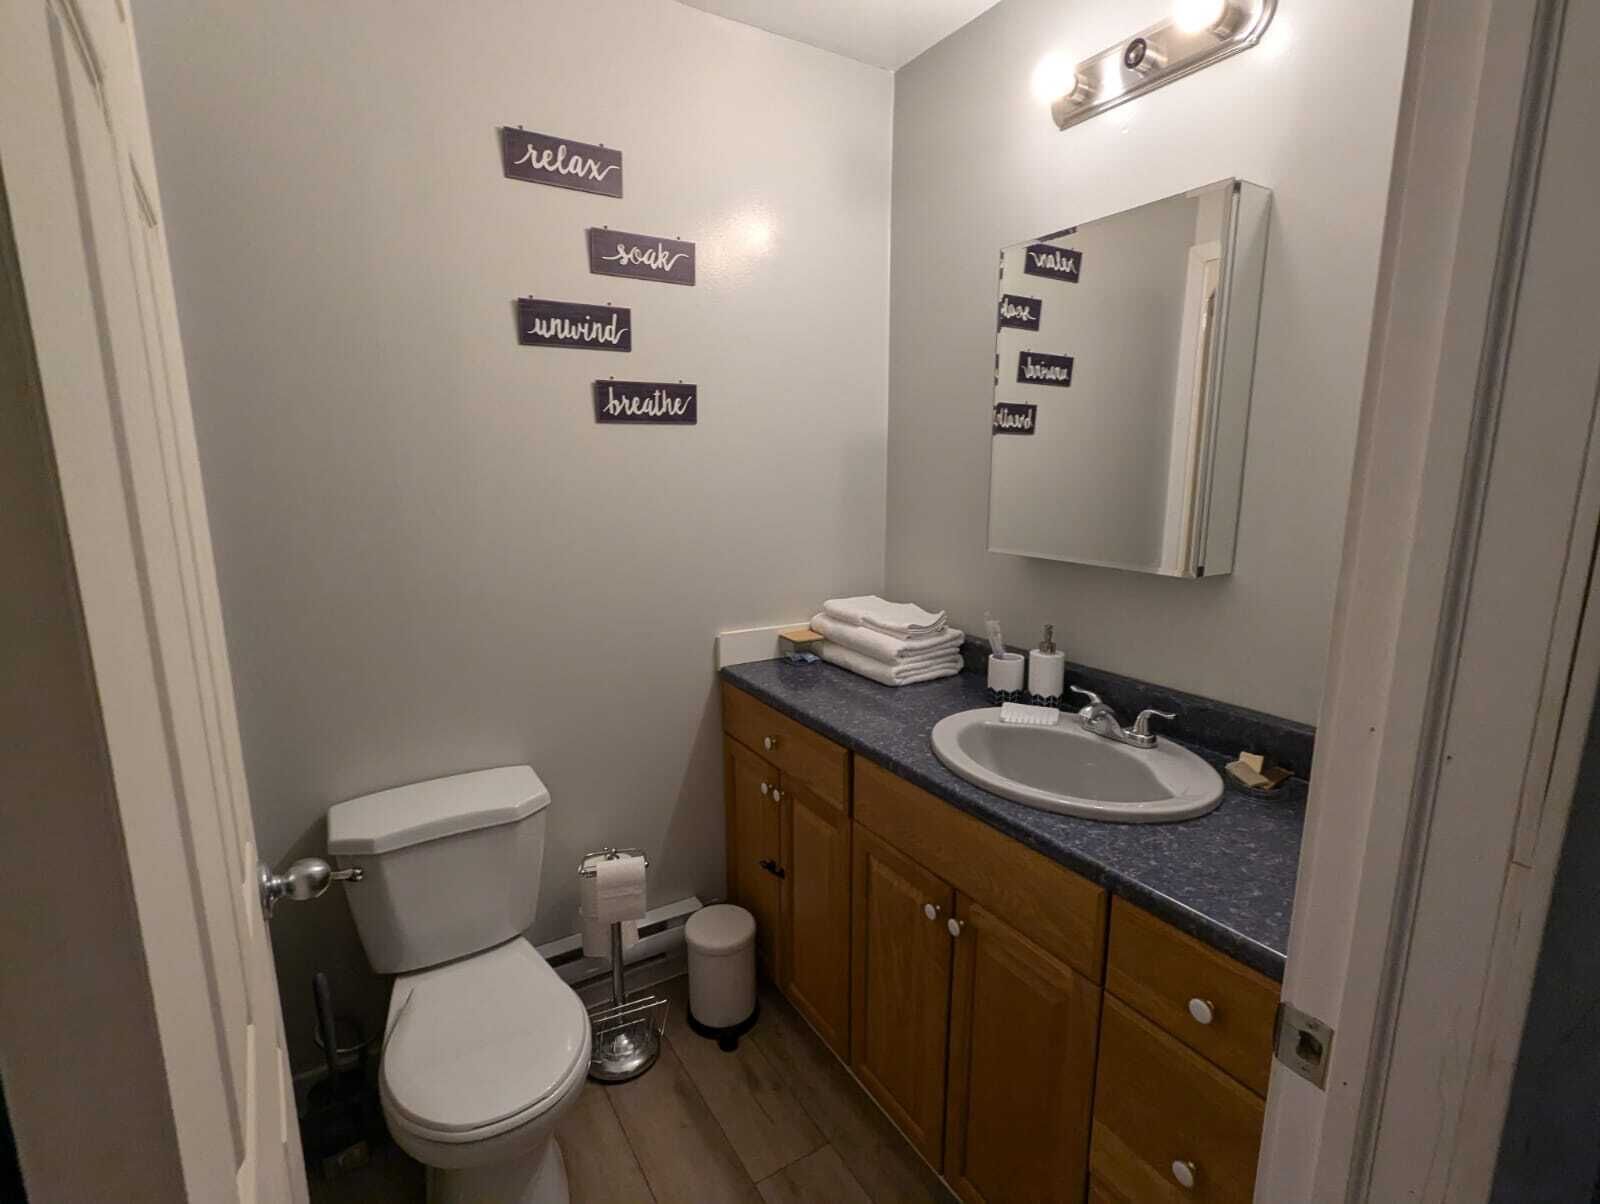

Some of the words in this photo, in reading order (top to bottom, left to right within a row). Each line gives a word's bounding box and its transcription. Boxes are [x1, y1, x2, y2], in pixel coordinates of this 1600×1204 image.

[514, 144, 620, 180] relax
[602, 243, 689, 271] soak
[528, 313, 629, 344] unwind
[603, 386, 692, 416] breathe
